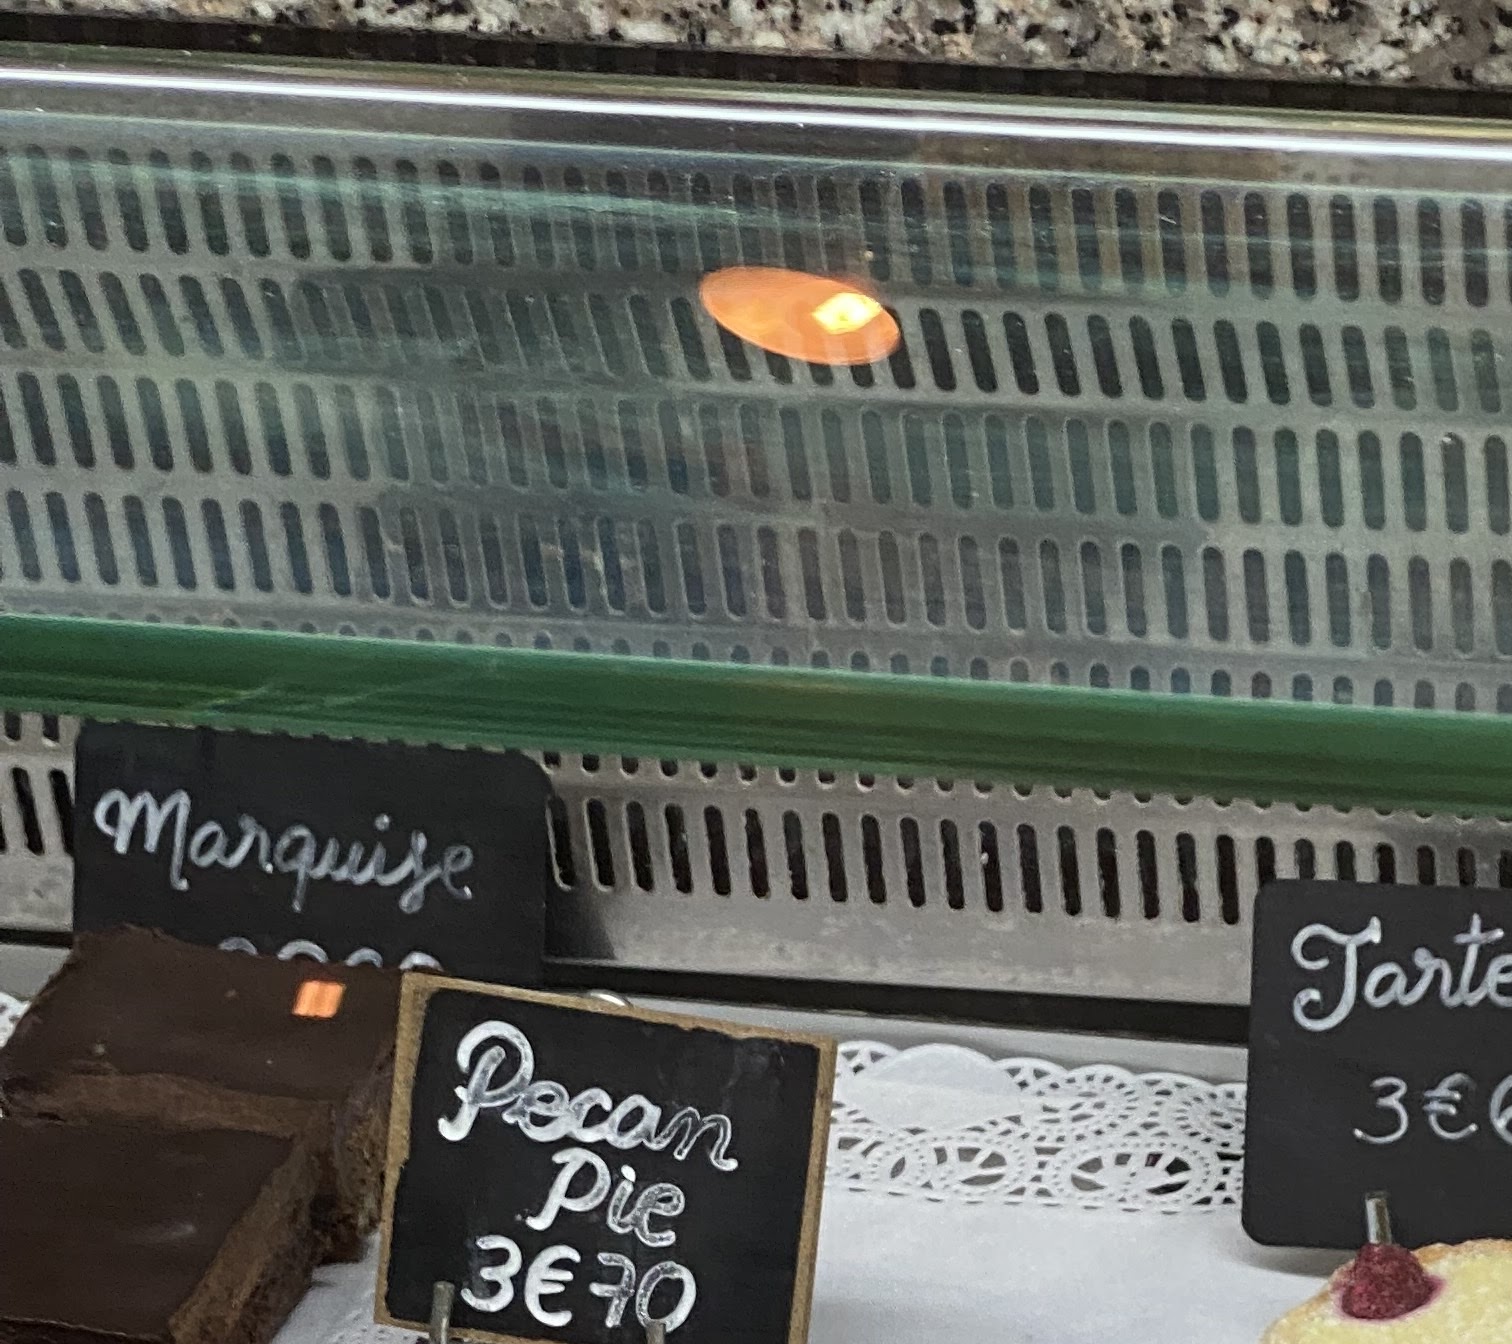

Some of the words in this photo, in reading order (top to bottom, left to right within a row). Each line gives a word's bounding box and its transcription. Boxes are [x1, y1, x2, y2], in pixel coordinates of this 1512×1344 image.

[94, 788, 474, 913] Marquise
[437, 1021, 738, 1172] Pecan
[526, 1147, 686, 1248] Pie
[461, 1235, 698, 1332] 3€70
